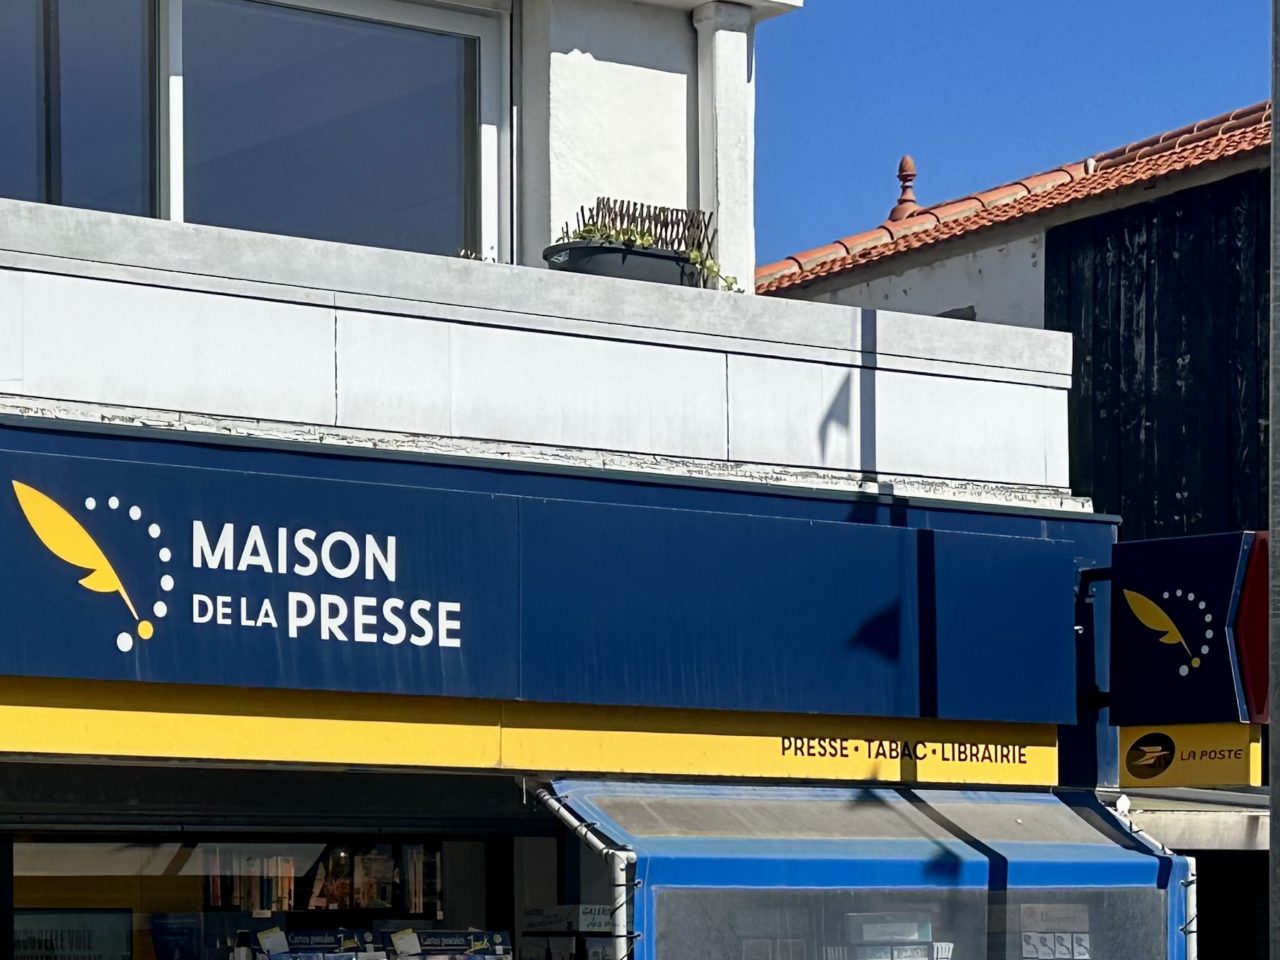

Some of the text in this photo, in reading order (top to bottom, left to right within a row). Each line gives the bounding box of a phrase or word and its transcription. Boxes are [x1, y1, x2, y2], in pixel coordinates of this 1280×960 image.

[192, 520, 397, 582] MAISON
[192, 591, 462, 648] DE LA PRESSE
[781, 736, 1028, 764] PRESSE TABAC LIBRAIRIE
[1180, 749, 1243, 761] LA POSTE
